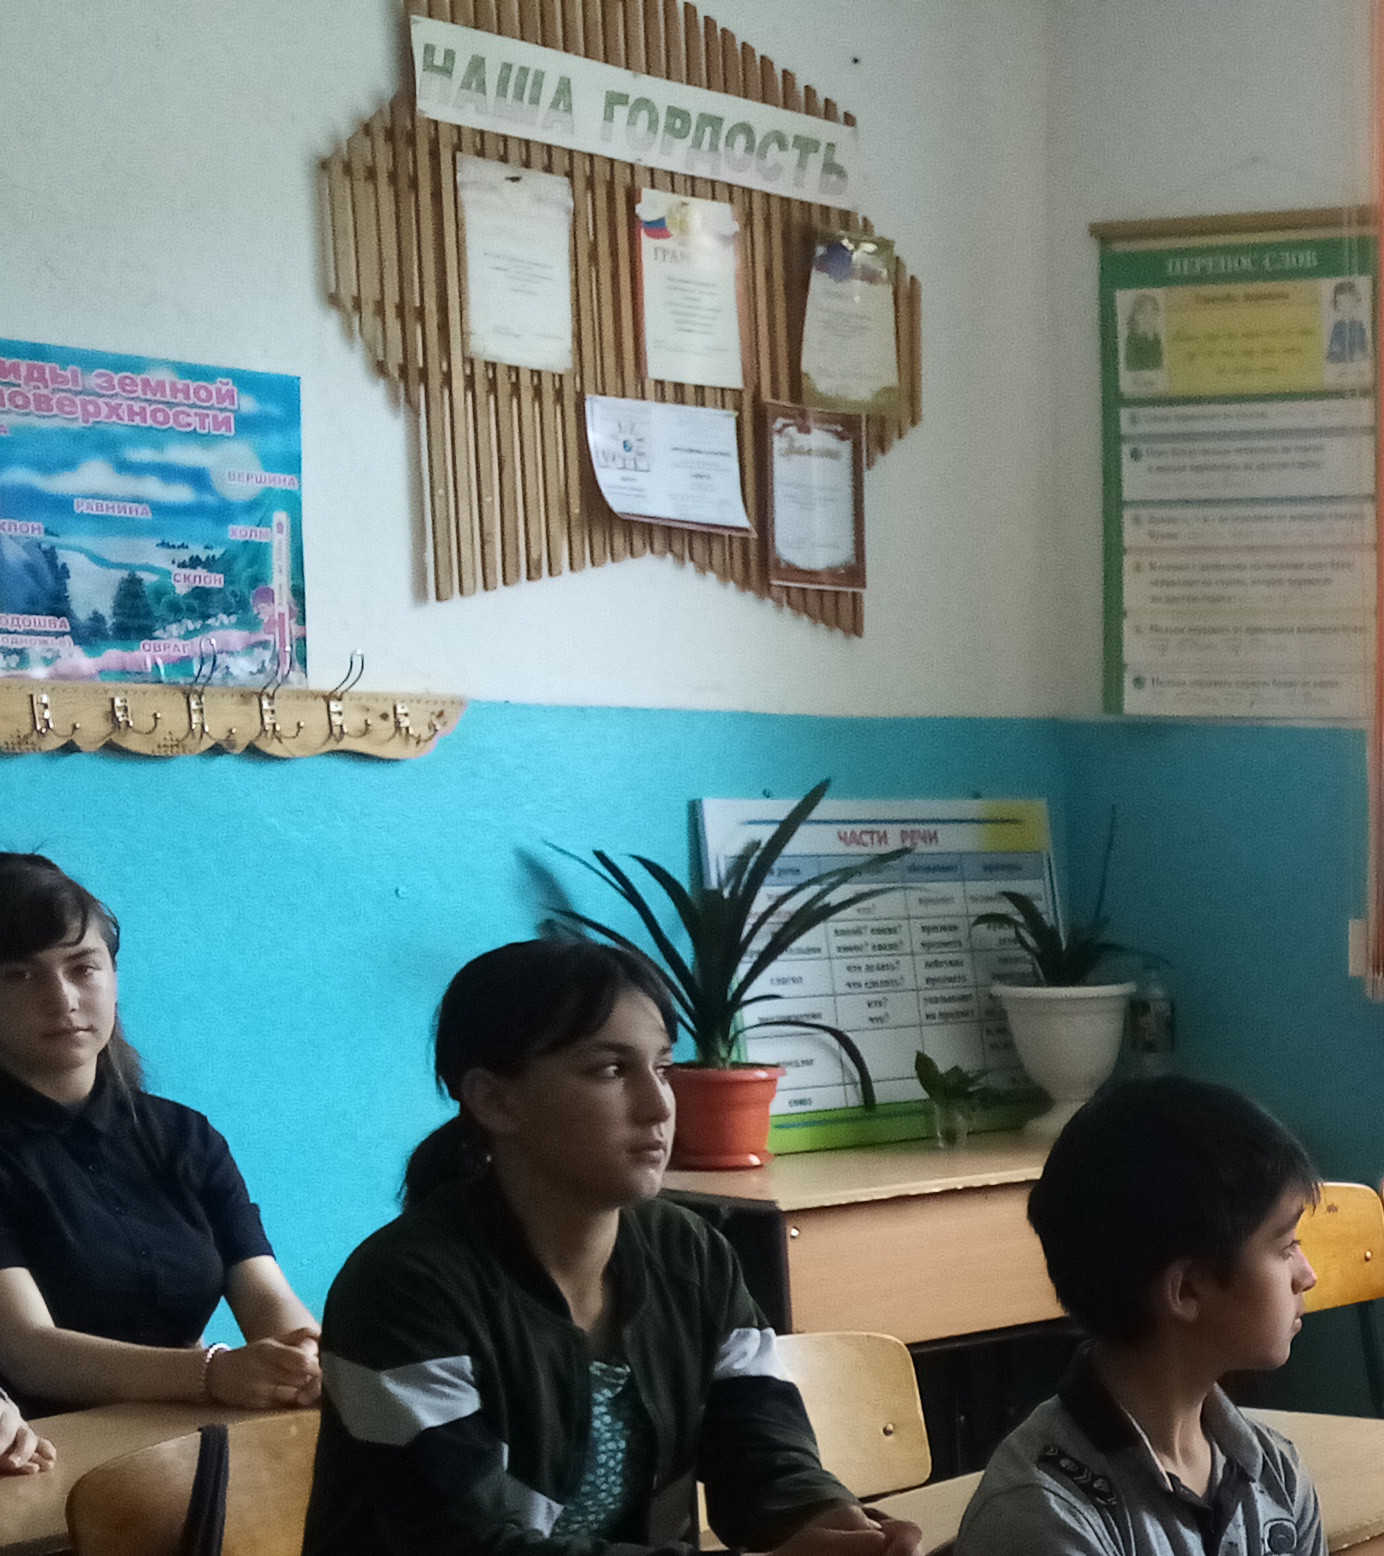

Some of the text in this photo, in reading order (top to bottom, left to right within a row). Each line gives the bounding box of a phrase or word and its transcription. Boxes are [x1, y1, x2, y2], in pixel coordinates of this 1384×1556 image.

[421, 42, 848, 195] НАША ГОРДОСТЬ
[0, 358, 237, 408] иды земной
[0, 387, 234, 434] оверхности
[227, 471, 297, 487] ВЕРШИНА
[75, 500, 150, 517] РАВНИНА
[0, 522, 42, 535] КЛОН
[173, 572, 222, 586] СКЛОН
[0, 616, 68, 631] ОДОШВА
[142, 641, 189, 654] ОВРАГ
[837, 829, 939, 847] ЧАСТИ РЕЧИ
